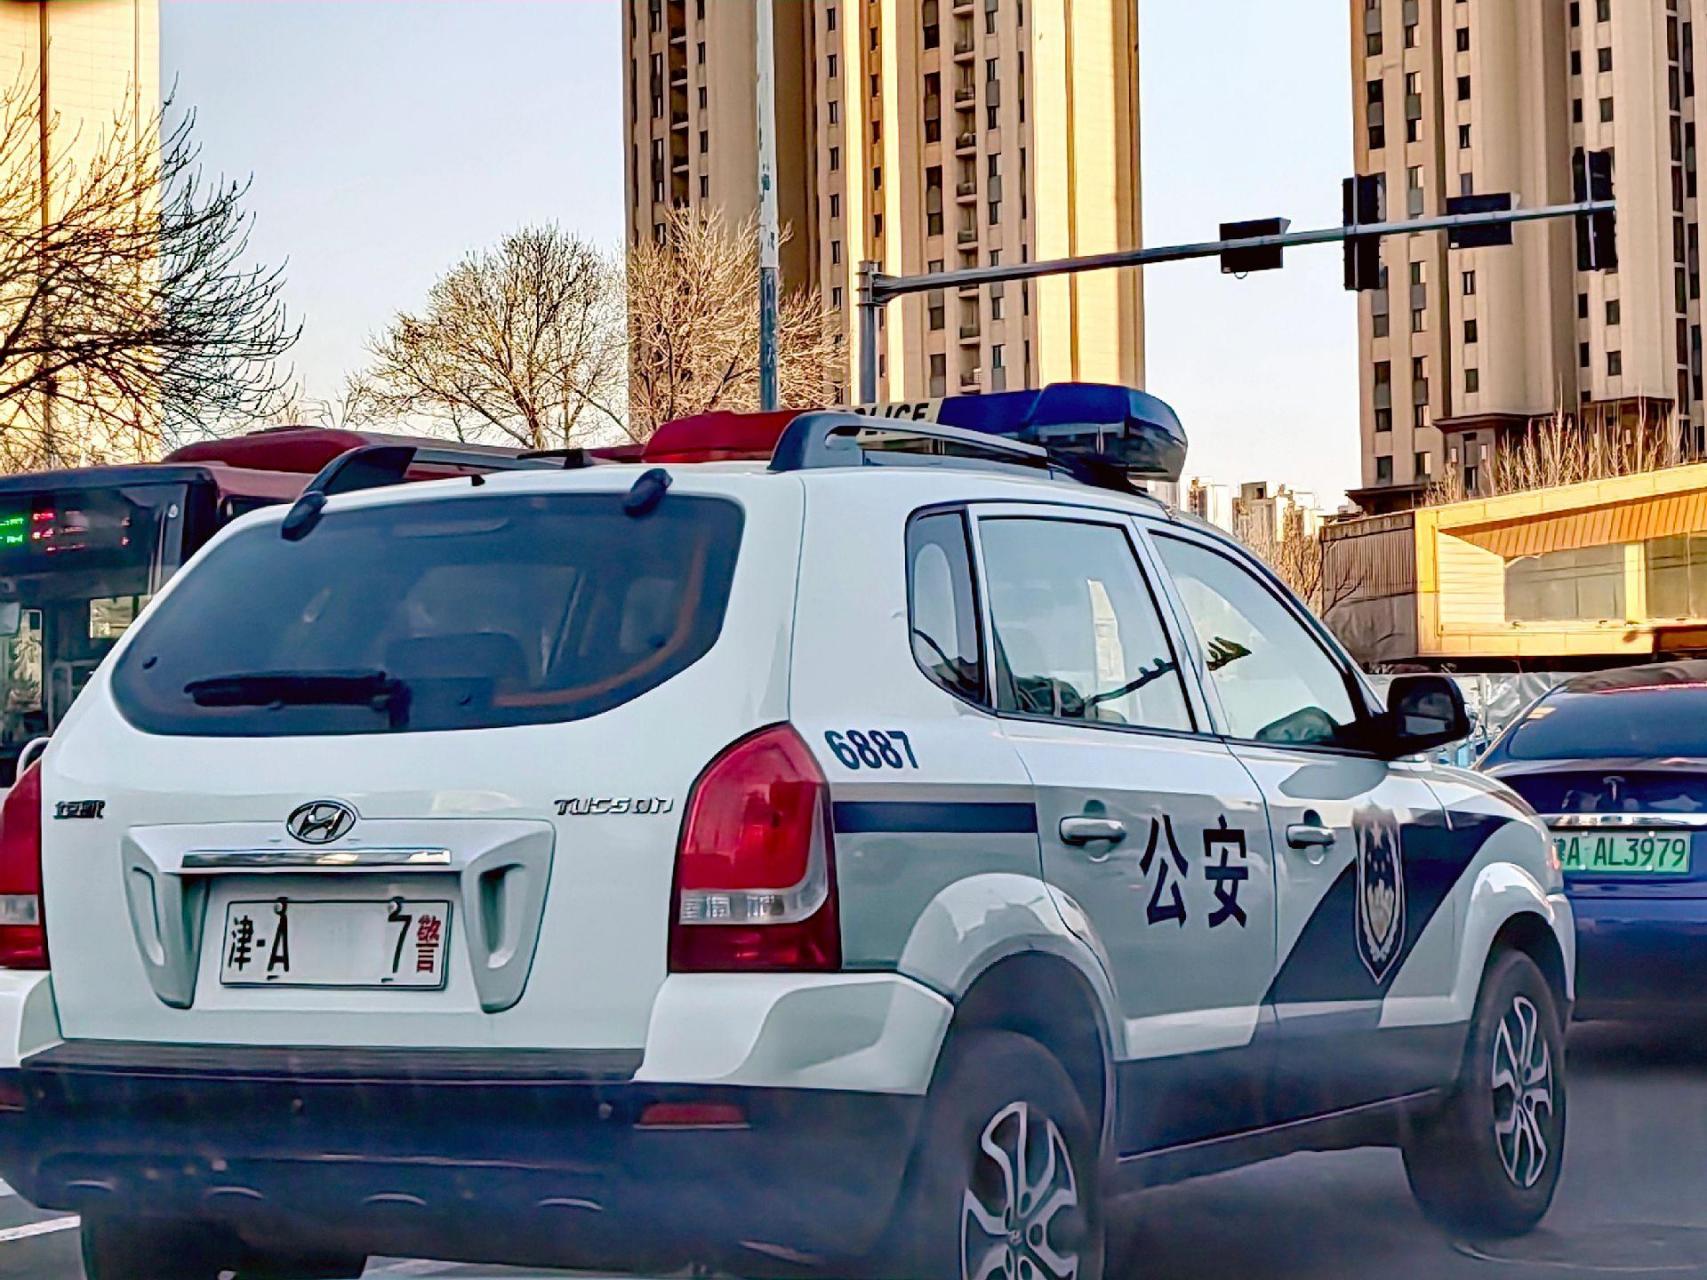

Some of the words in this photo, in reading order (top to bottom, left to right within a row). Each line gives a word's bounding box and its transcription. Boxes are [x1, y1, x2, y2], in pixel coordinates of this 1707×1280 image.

[824, 730, 919, 769] 6887
[554, 797, 674, 815] TUCSON
[1594, 837, 1686, 866] AL3979
[1139, 814, 1249, 928] 公安
